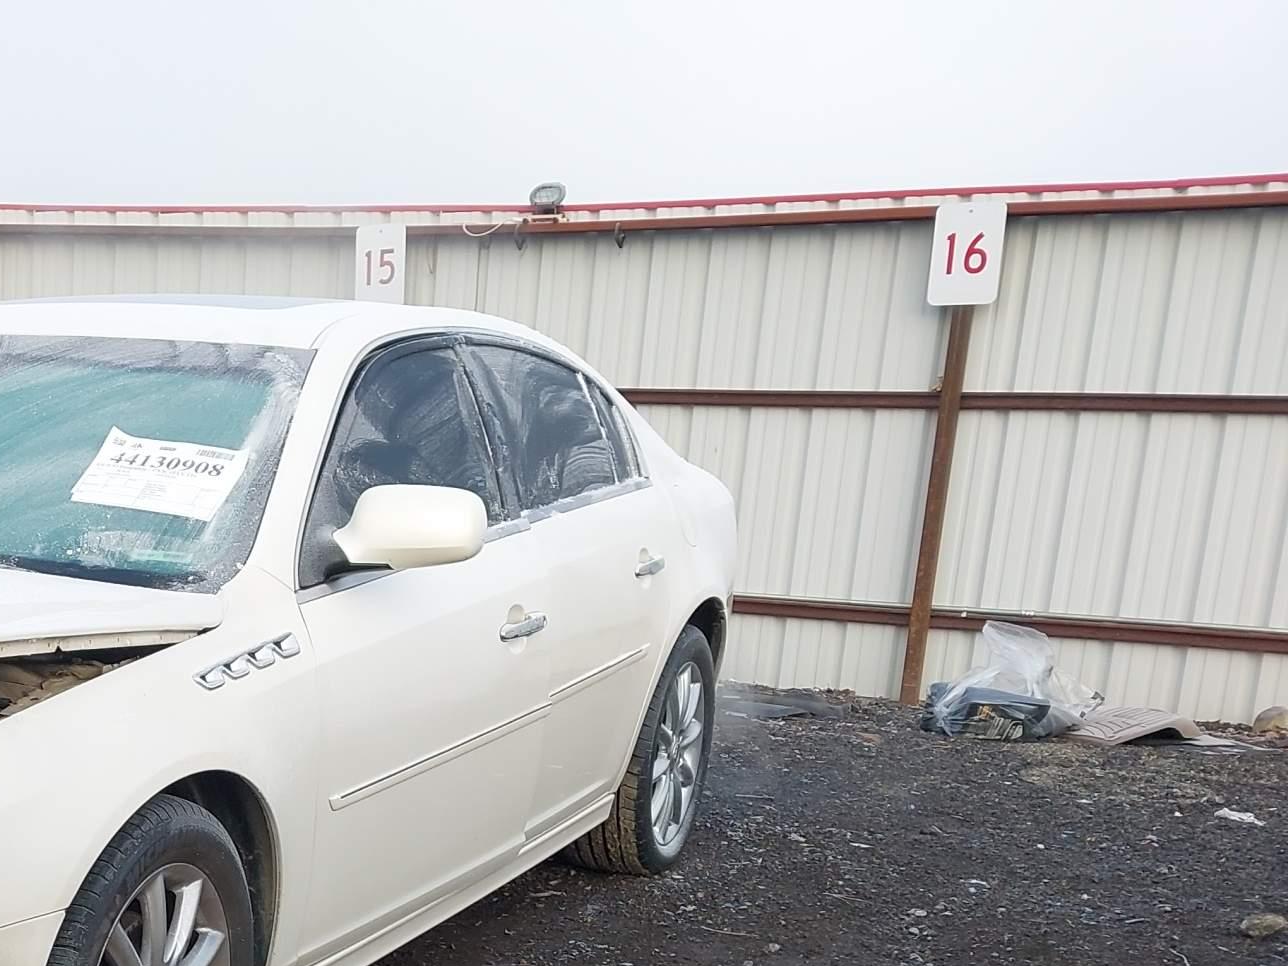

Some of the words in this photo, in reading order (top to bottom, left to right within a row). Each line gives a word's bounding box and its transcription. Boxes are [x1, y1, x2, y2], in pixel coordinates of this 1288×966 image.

[364, 247, 396, 287] 15
[945, 231, 988, 275] 16
[109, 451, 225, 478] 44130908
